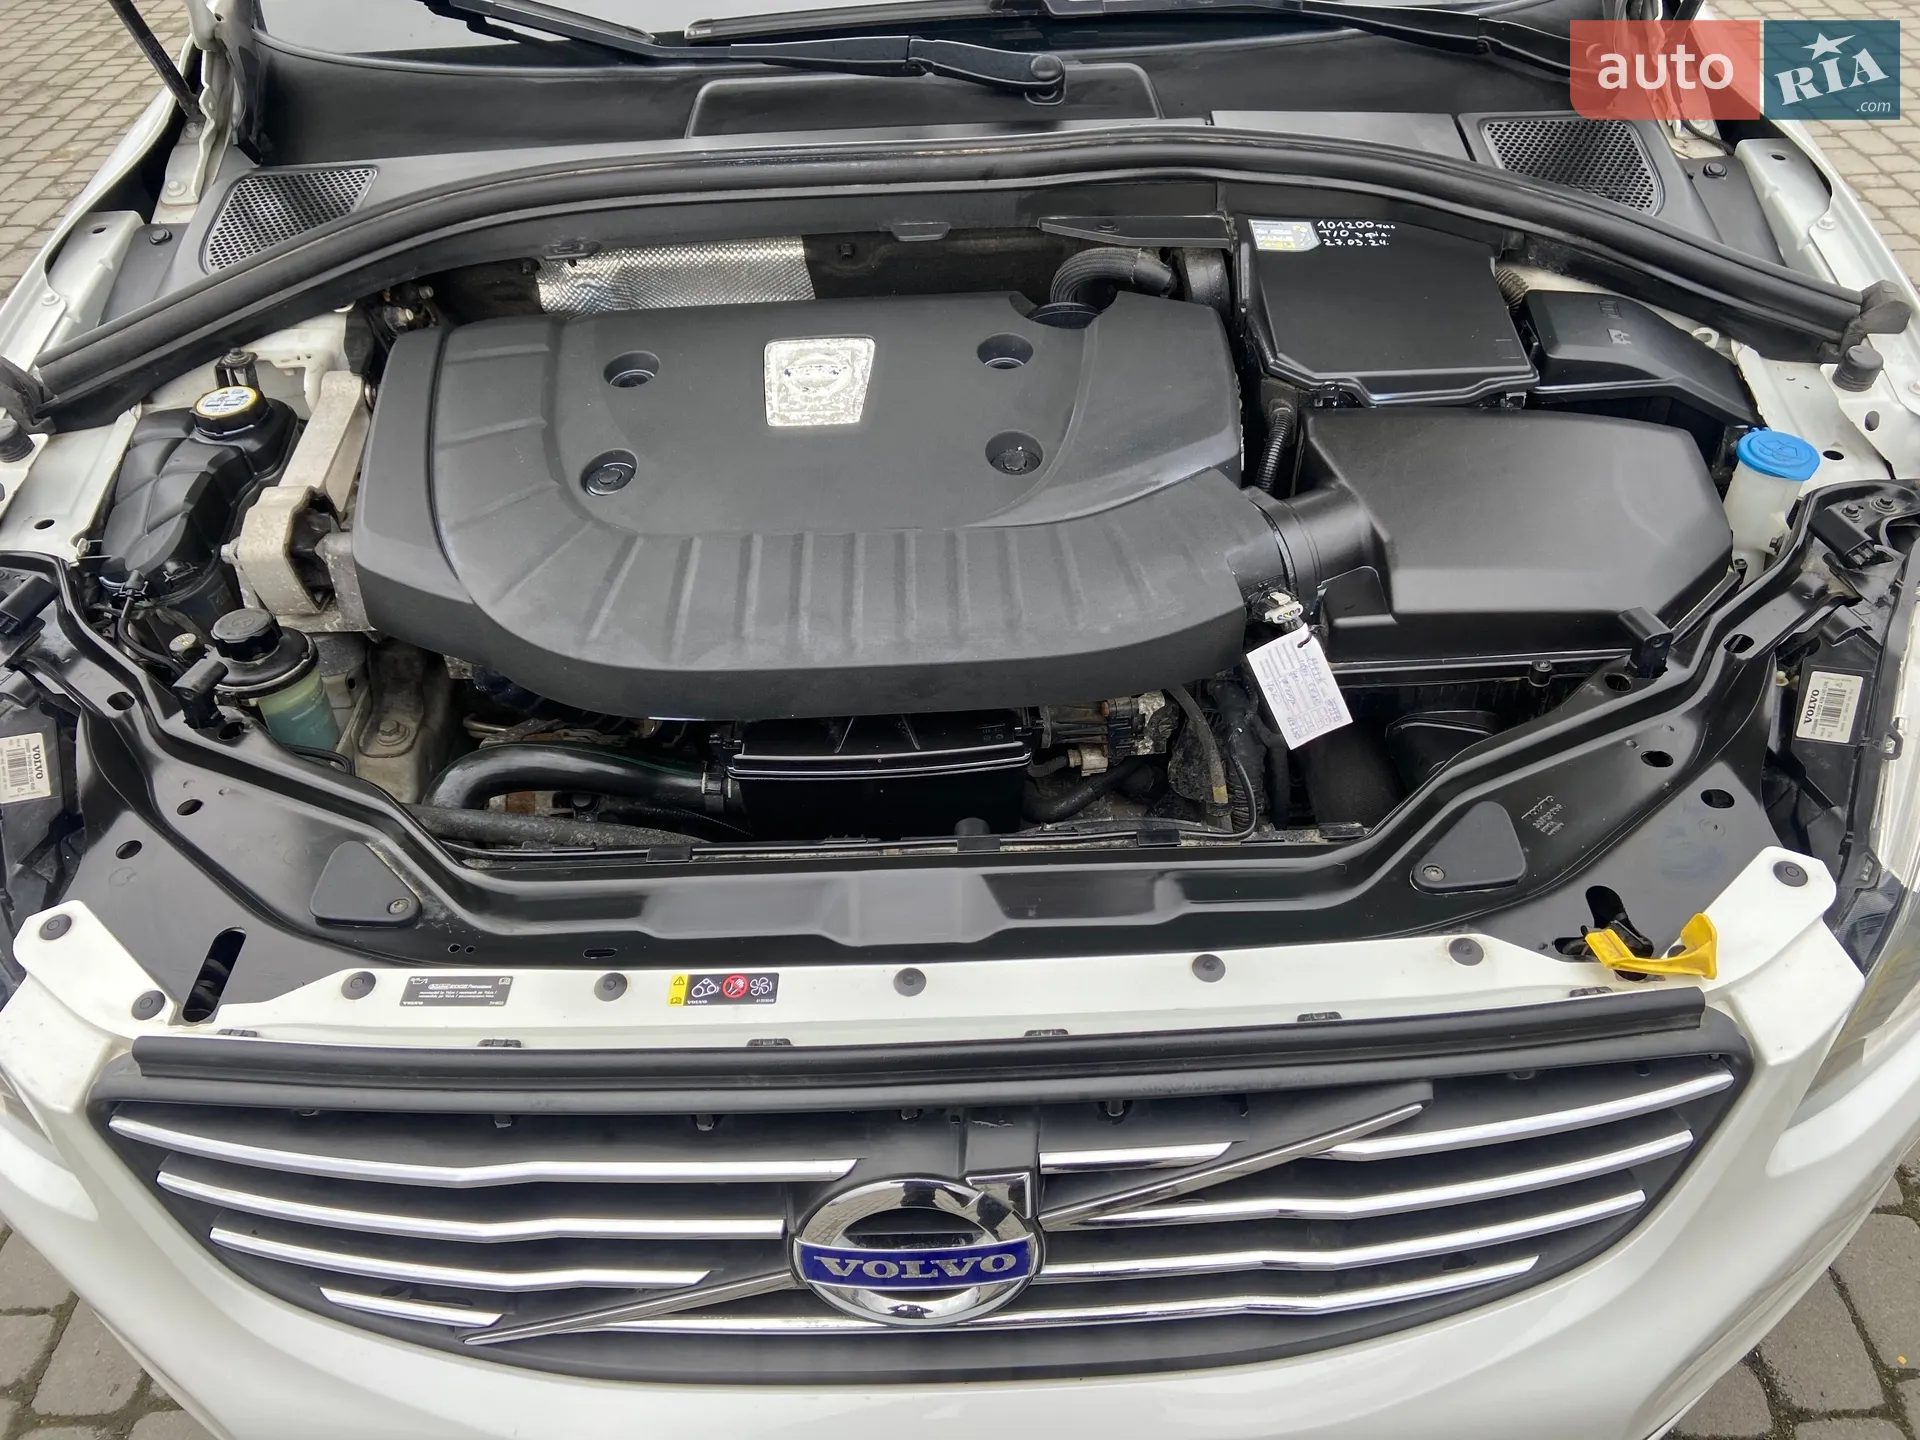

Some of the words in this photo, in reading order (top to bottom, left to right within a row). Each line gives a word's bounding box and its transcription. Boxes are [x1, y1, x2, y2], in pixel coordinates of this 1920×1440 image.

[1317, 220, 1374, 229] 101200
[1803, 689, 1820, 725] VOLVO
[32, 744, 44, 780] VOLVO
[814, 1253, 1017, 1279] VOLVO
